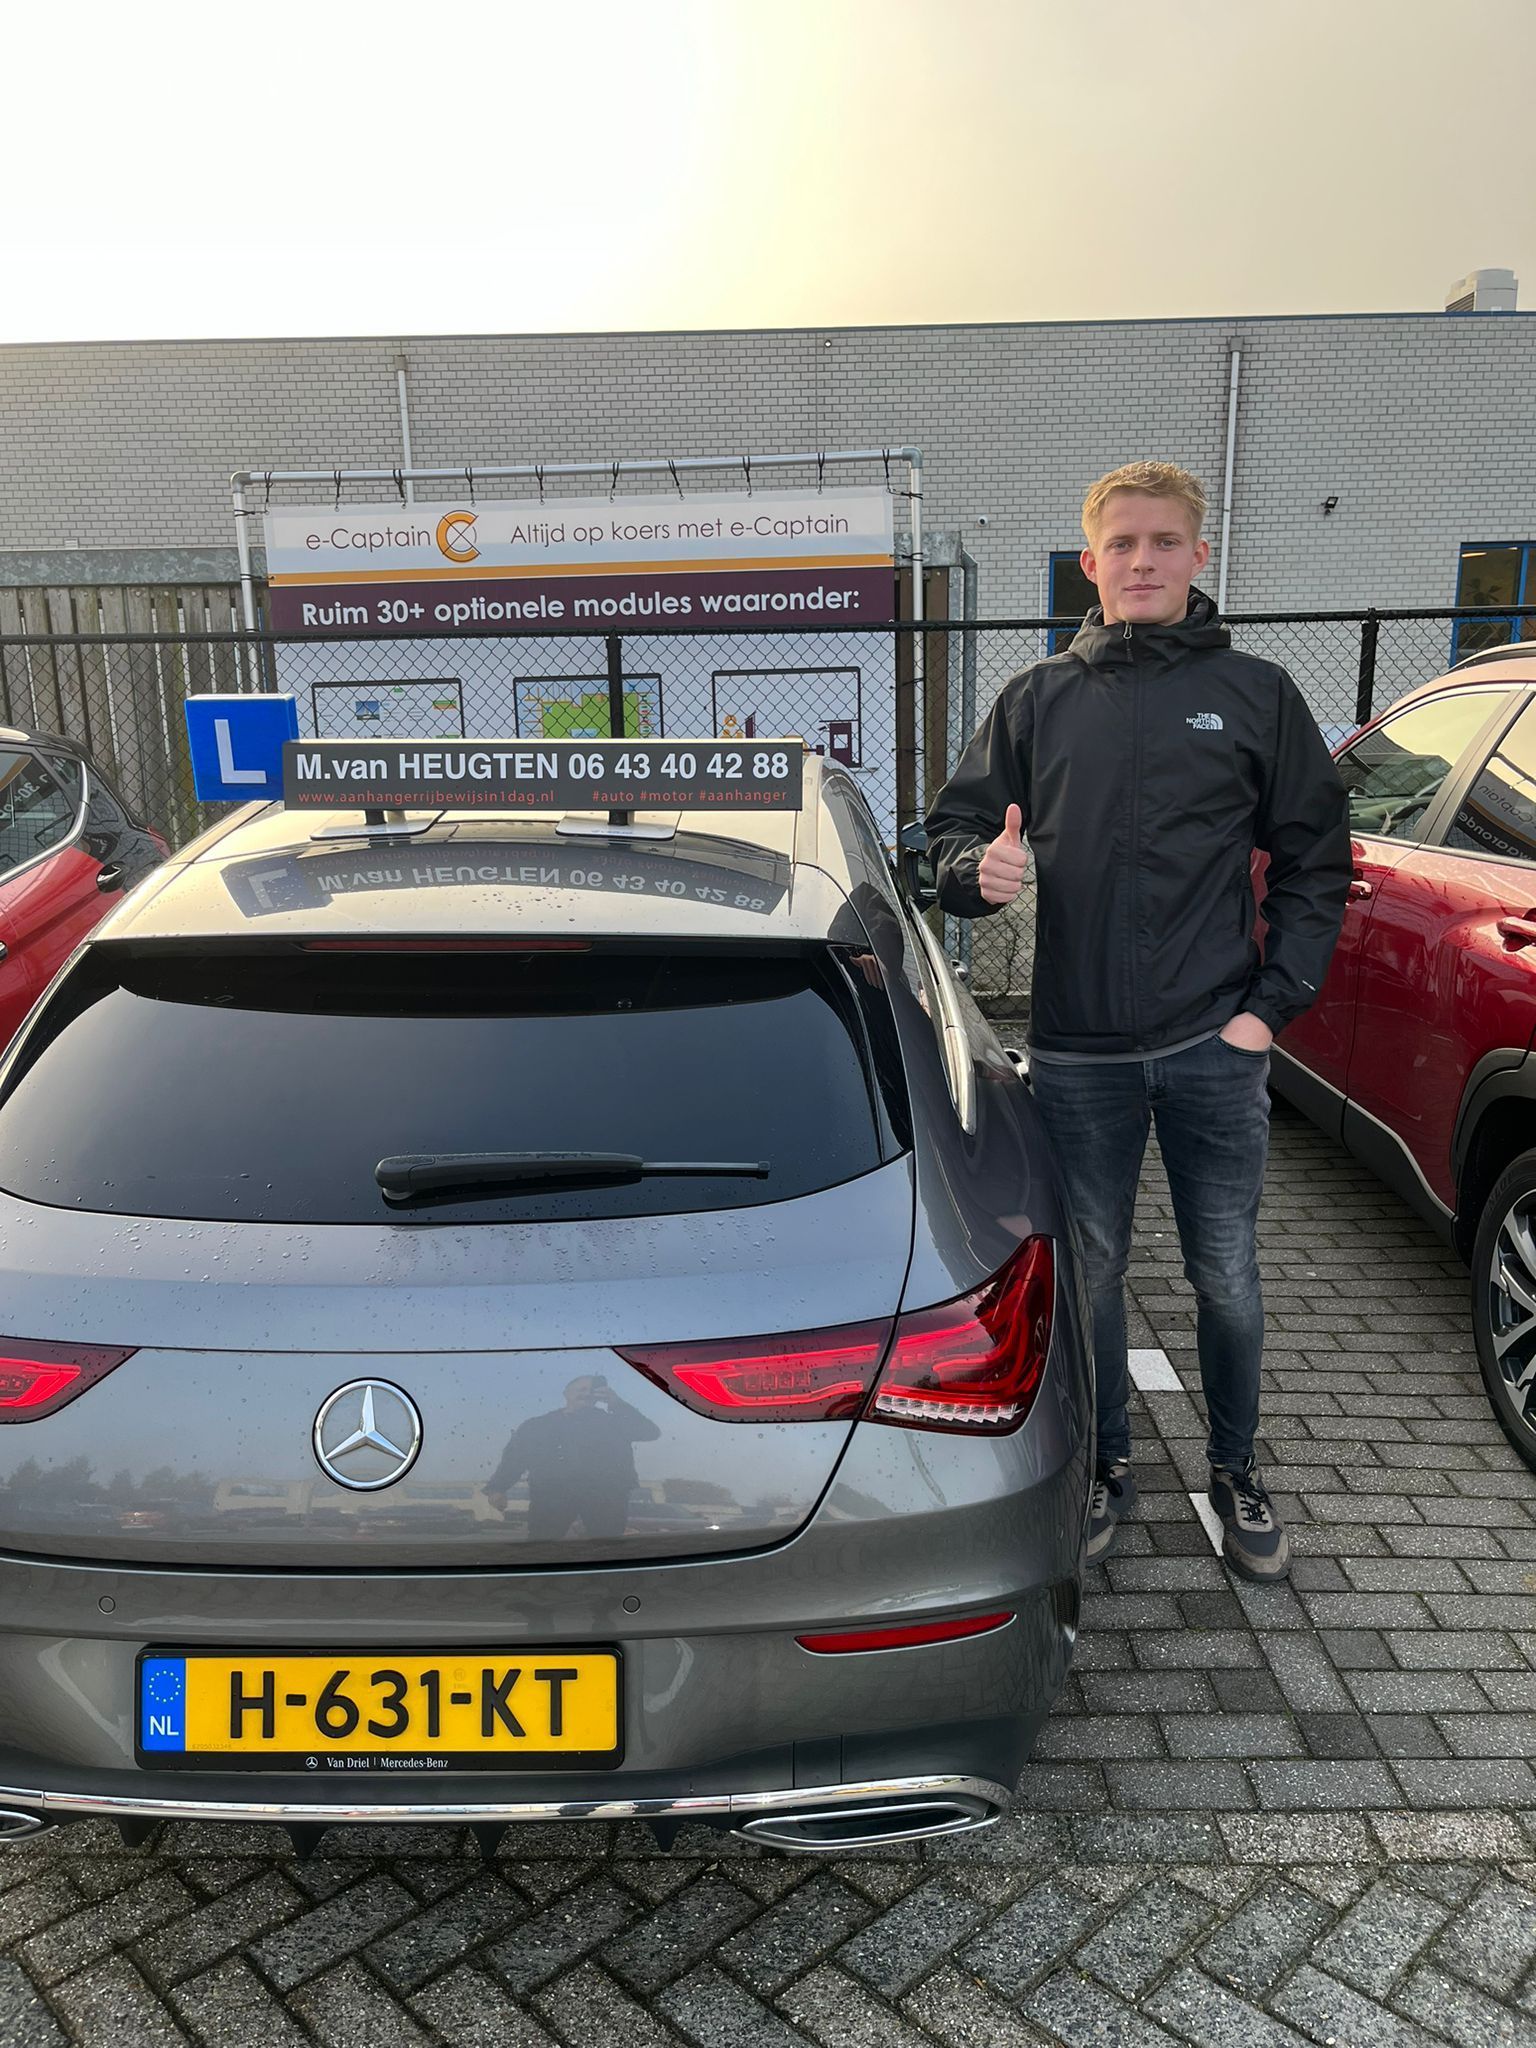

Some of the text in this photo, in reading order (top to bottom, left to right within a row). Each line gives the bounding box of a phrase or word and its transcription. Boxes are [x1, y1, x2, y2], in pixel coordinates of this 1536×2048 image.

[306, 526, 431, 552] e-Captain
[511, 514, 849, 548] Altijd op koers met e-Captain
[302, 586, 860, 626] Ruim 30+ optionele modules waaronder:
[214, 719, 267, 784] L
[296, 752, 789, 780] M.van HEUGTEN 06 43 40 42 88
[298, 790, 554, 805] www.aanhangerrijbewijsin1dag.nl
[592, 789, 787, 803] #auto #motor #aanhanger
[229, 1668, 578, 1739] H-631-KT
[149, 1715, 179, 1736] NL
[326, 1757, 449, 1768] Van Driel Mercedes-Benz
